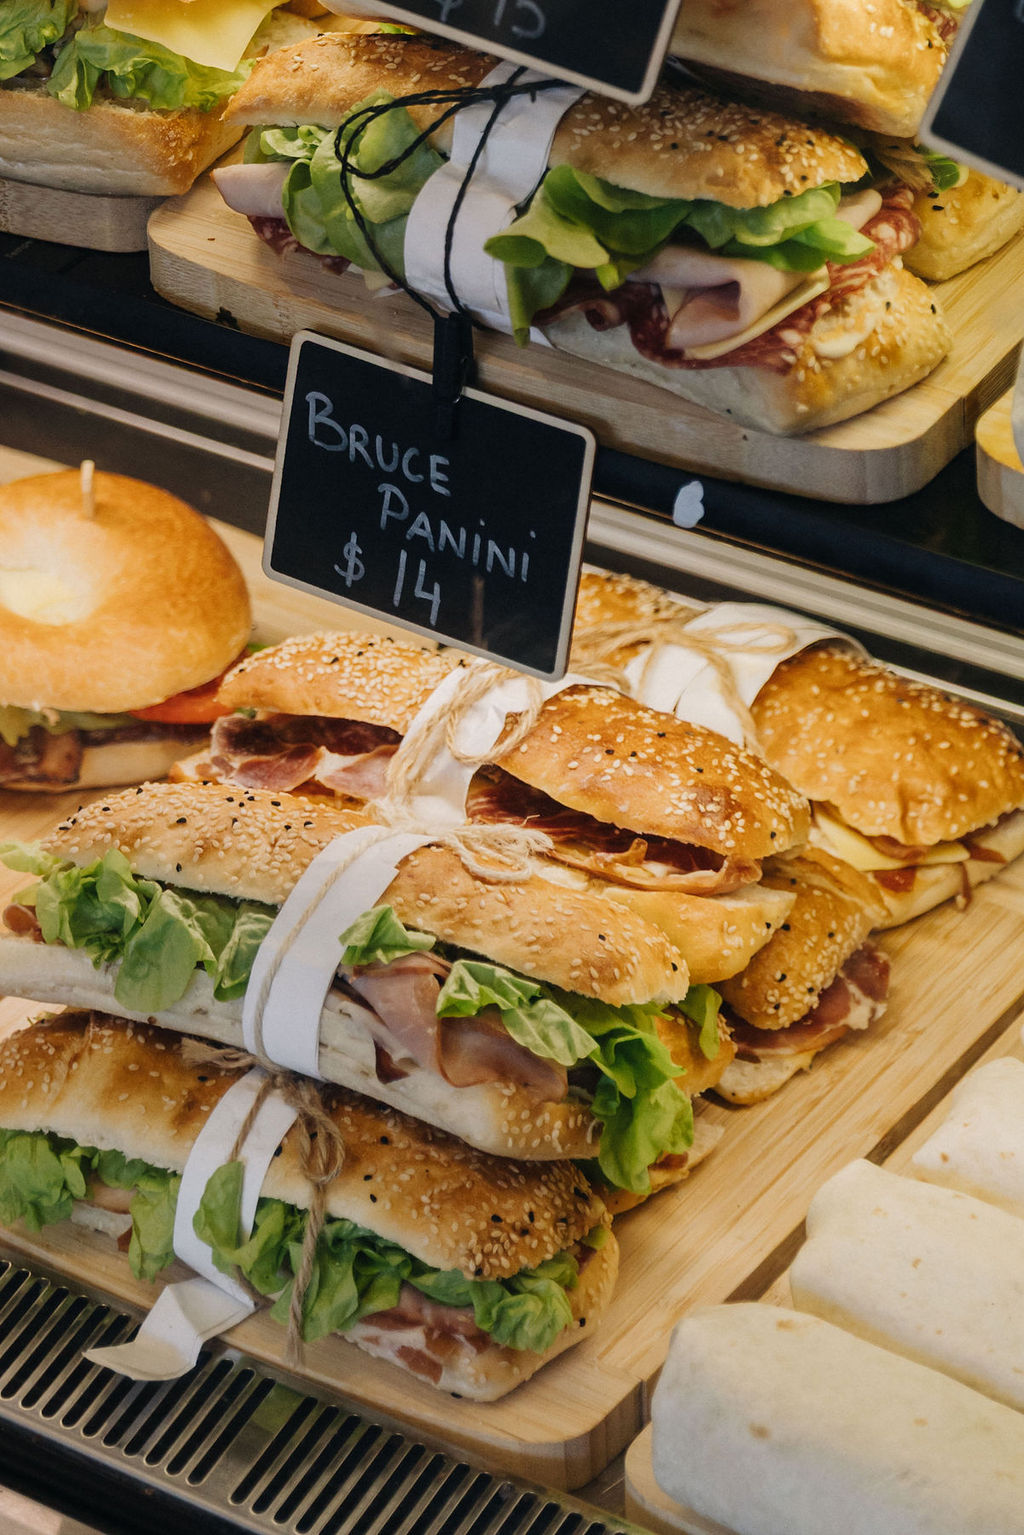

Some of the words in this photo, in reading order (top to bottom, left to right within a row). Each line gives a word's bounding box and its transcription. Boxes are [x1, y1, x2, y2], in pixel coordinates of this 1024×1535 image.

[305, 390, 452, 498] BRUCE
[333, 531, 365, 588] $
[393, 549, 441, 627] 14
